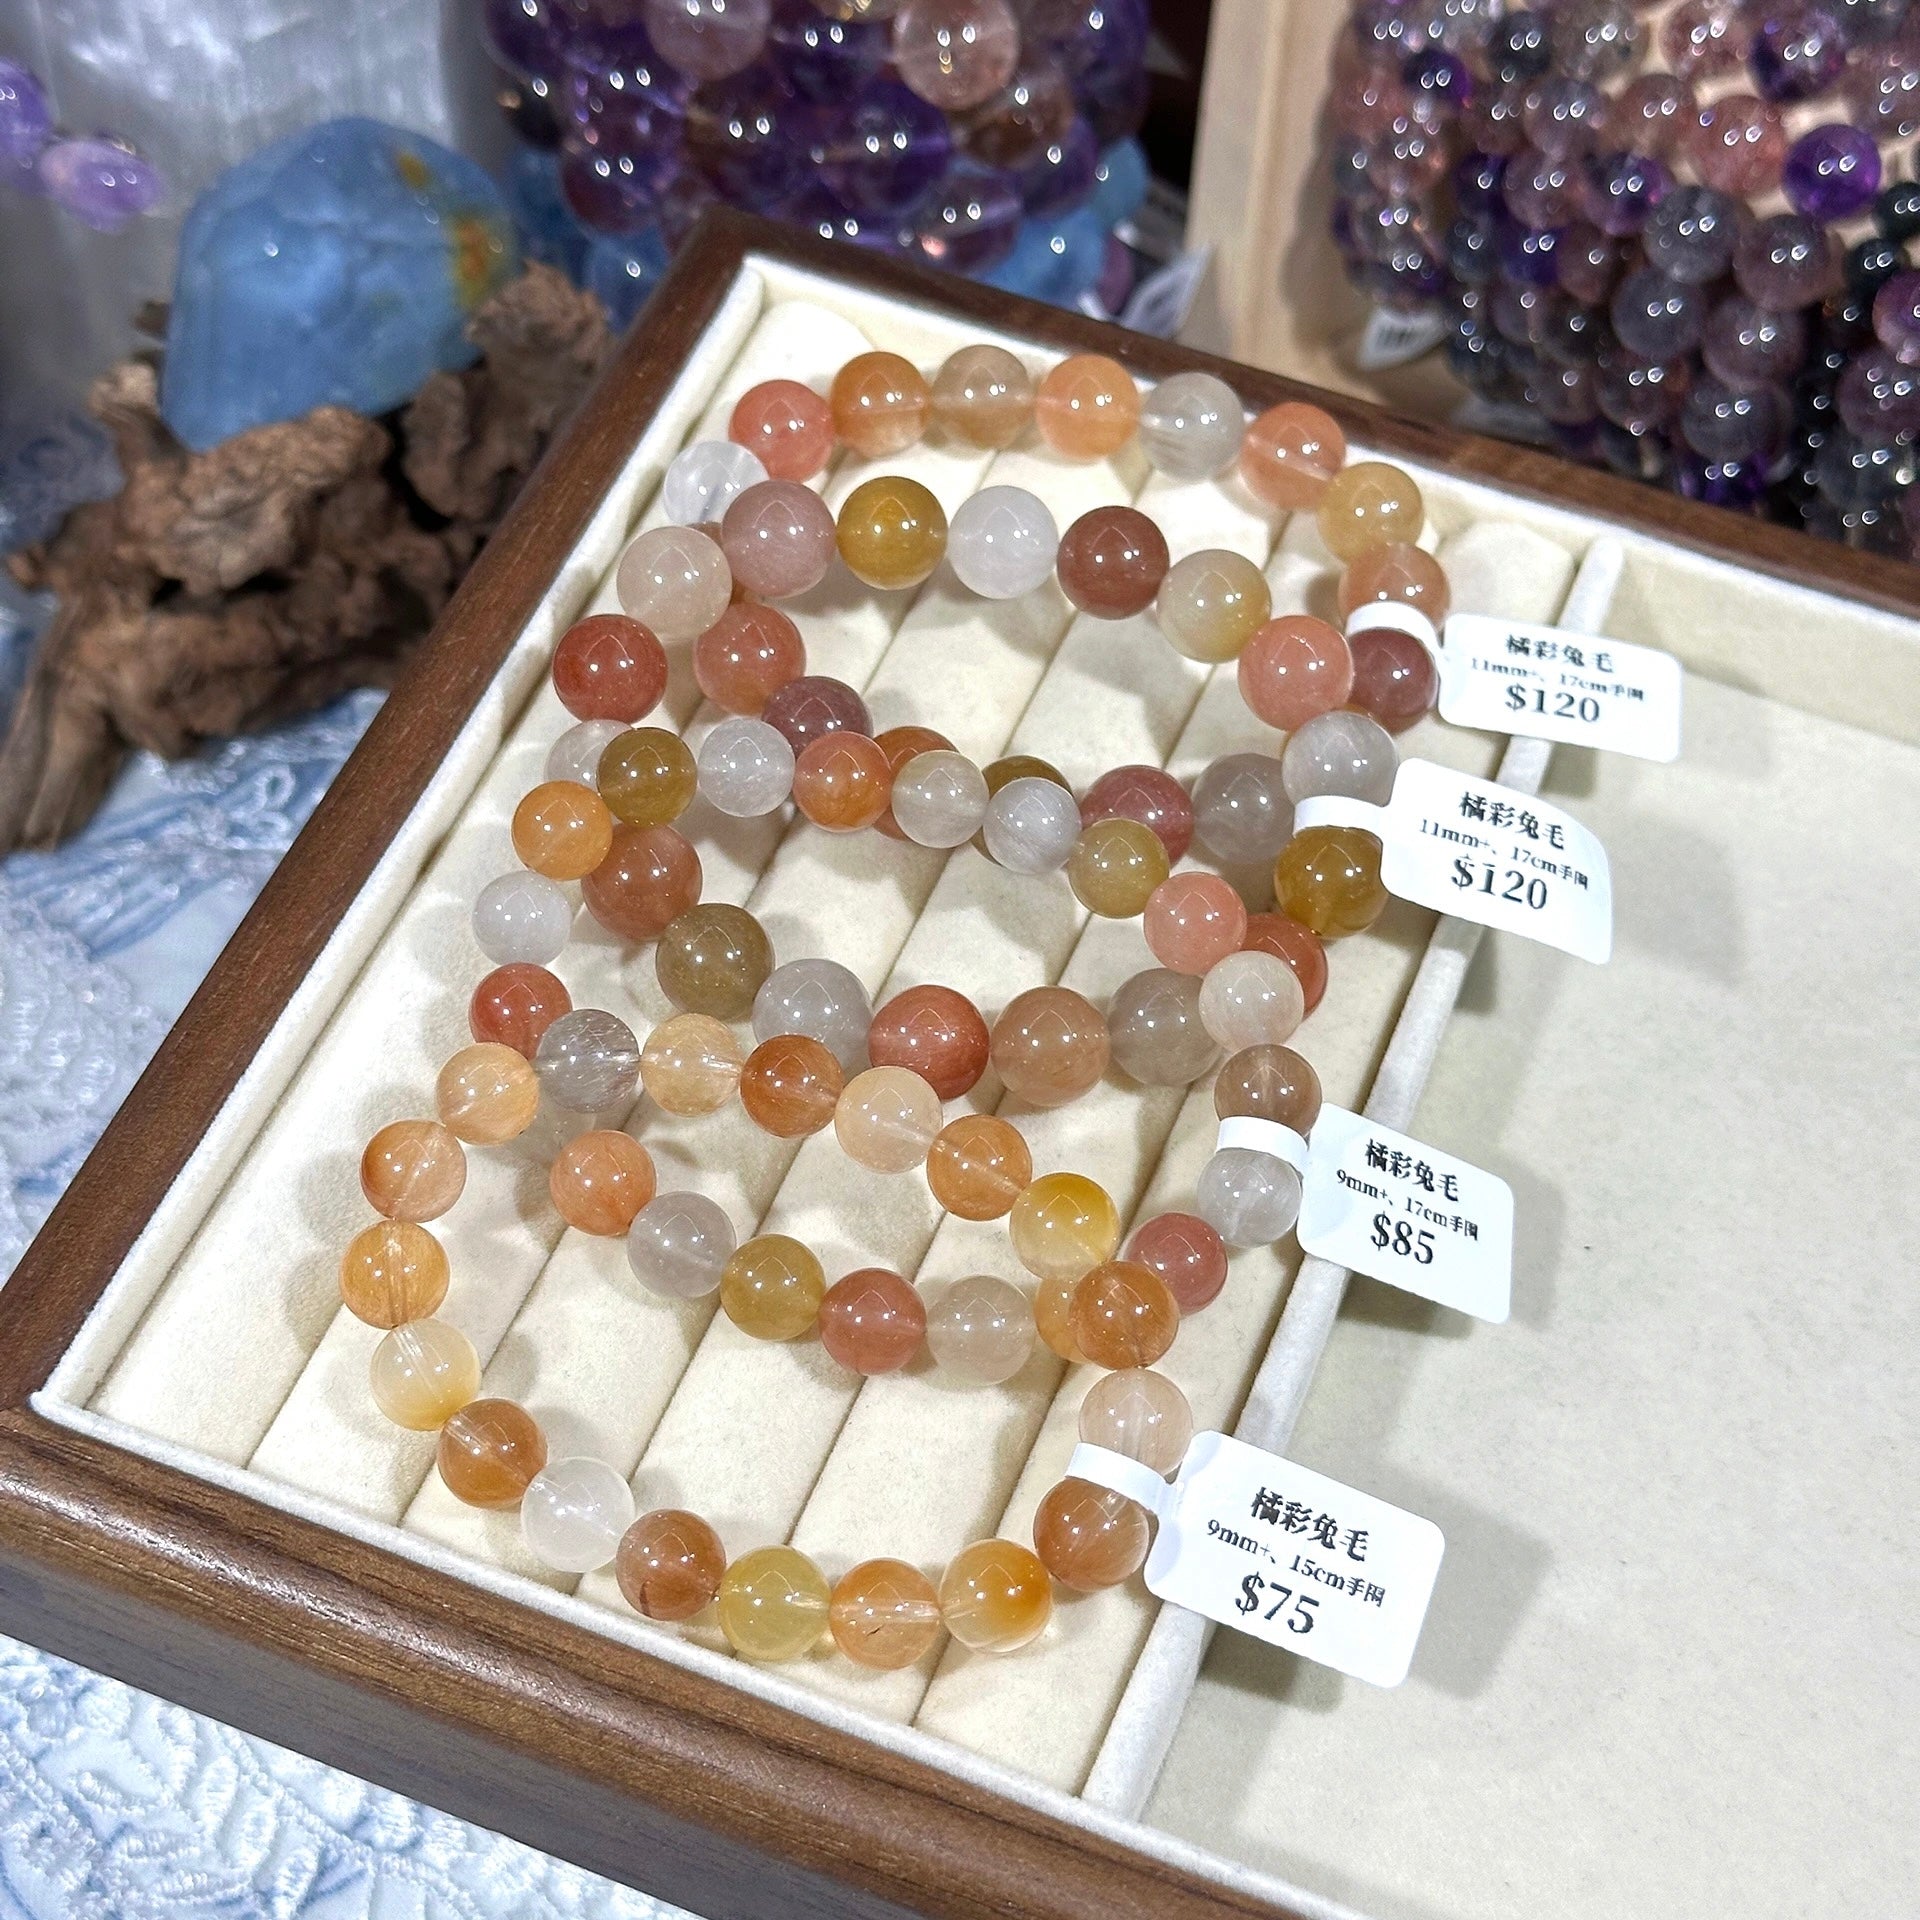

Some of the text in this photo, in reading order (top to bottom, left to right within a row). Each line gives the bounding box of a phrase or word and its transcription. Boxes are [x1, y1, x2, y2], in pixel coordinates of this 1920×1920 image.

[1504, 683, 1600, 722] $120
[1459, 791, 1565, 850] 橘彩兔毛
[1451, 854, 1548, 910] $120
[1365, 1138, 1459, 1202] 橘彩兔毛
[1370, 1211, 1435, 1264] $85
[1251, 1486, 1369, 1562] 橘彩兔毛
[1235, 1571, 1320, 1635] $75
